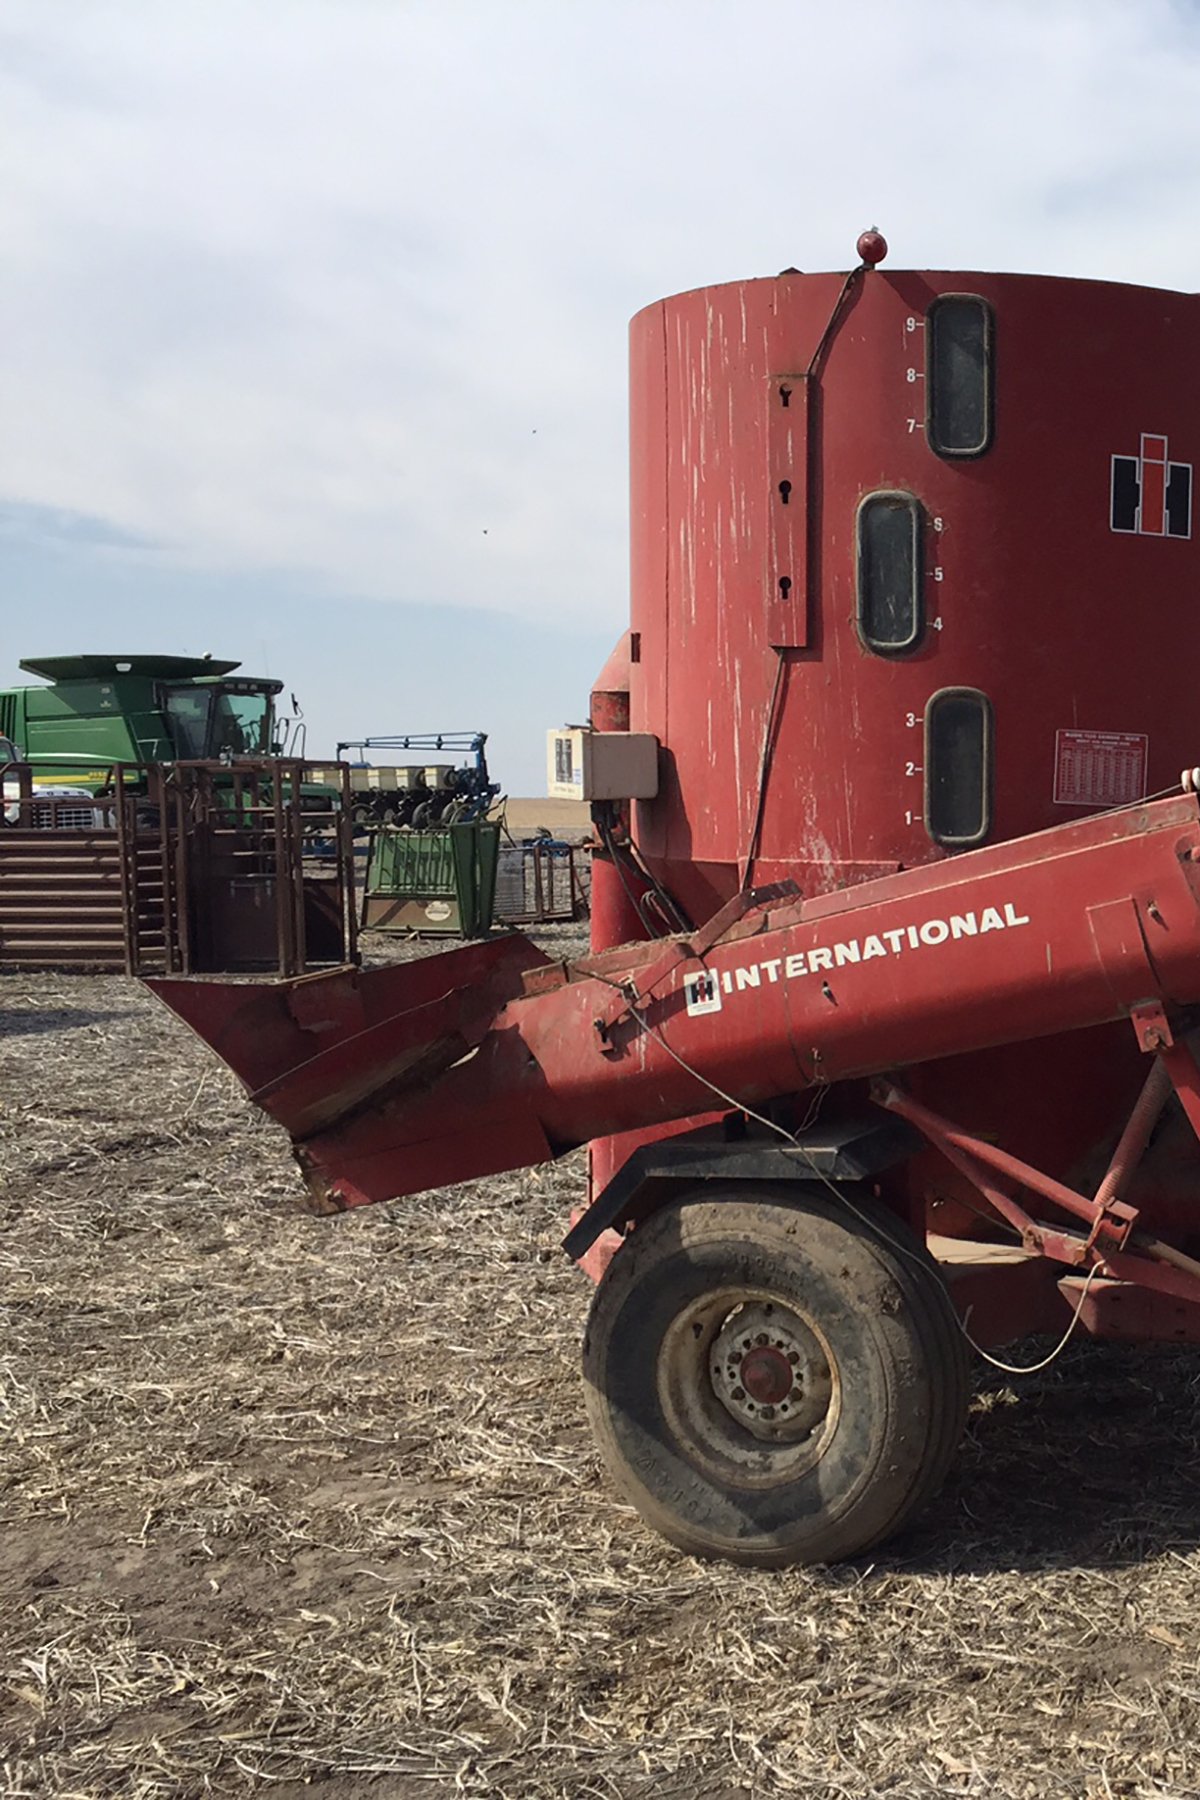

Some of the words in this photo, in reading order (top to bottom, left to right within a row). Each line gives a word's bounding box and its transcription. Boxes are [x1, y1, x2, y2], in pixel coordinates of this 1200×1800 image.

[906, 316, 916, 332] 9
[906, 368, 916, 382] 8
[906, 418, 916, 433] 7
[934, 566, 944, 581] 5
[933, 616, 943, 631] 4
[905, 712, 915, 727] 3
[905, 762, 915, 776] 2
[904, 811, 912, 825] 1
[721, 903, 1030, 994] INTERNATIONAL
